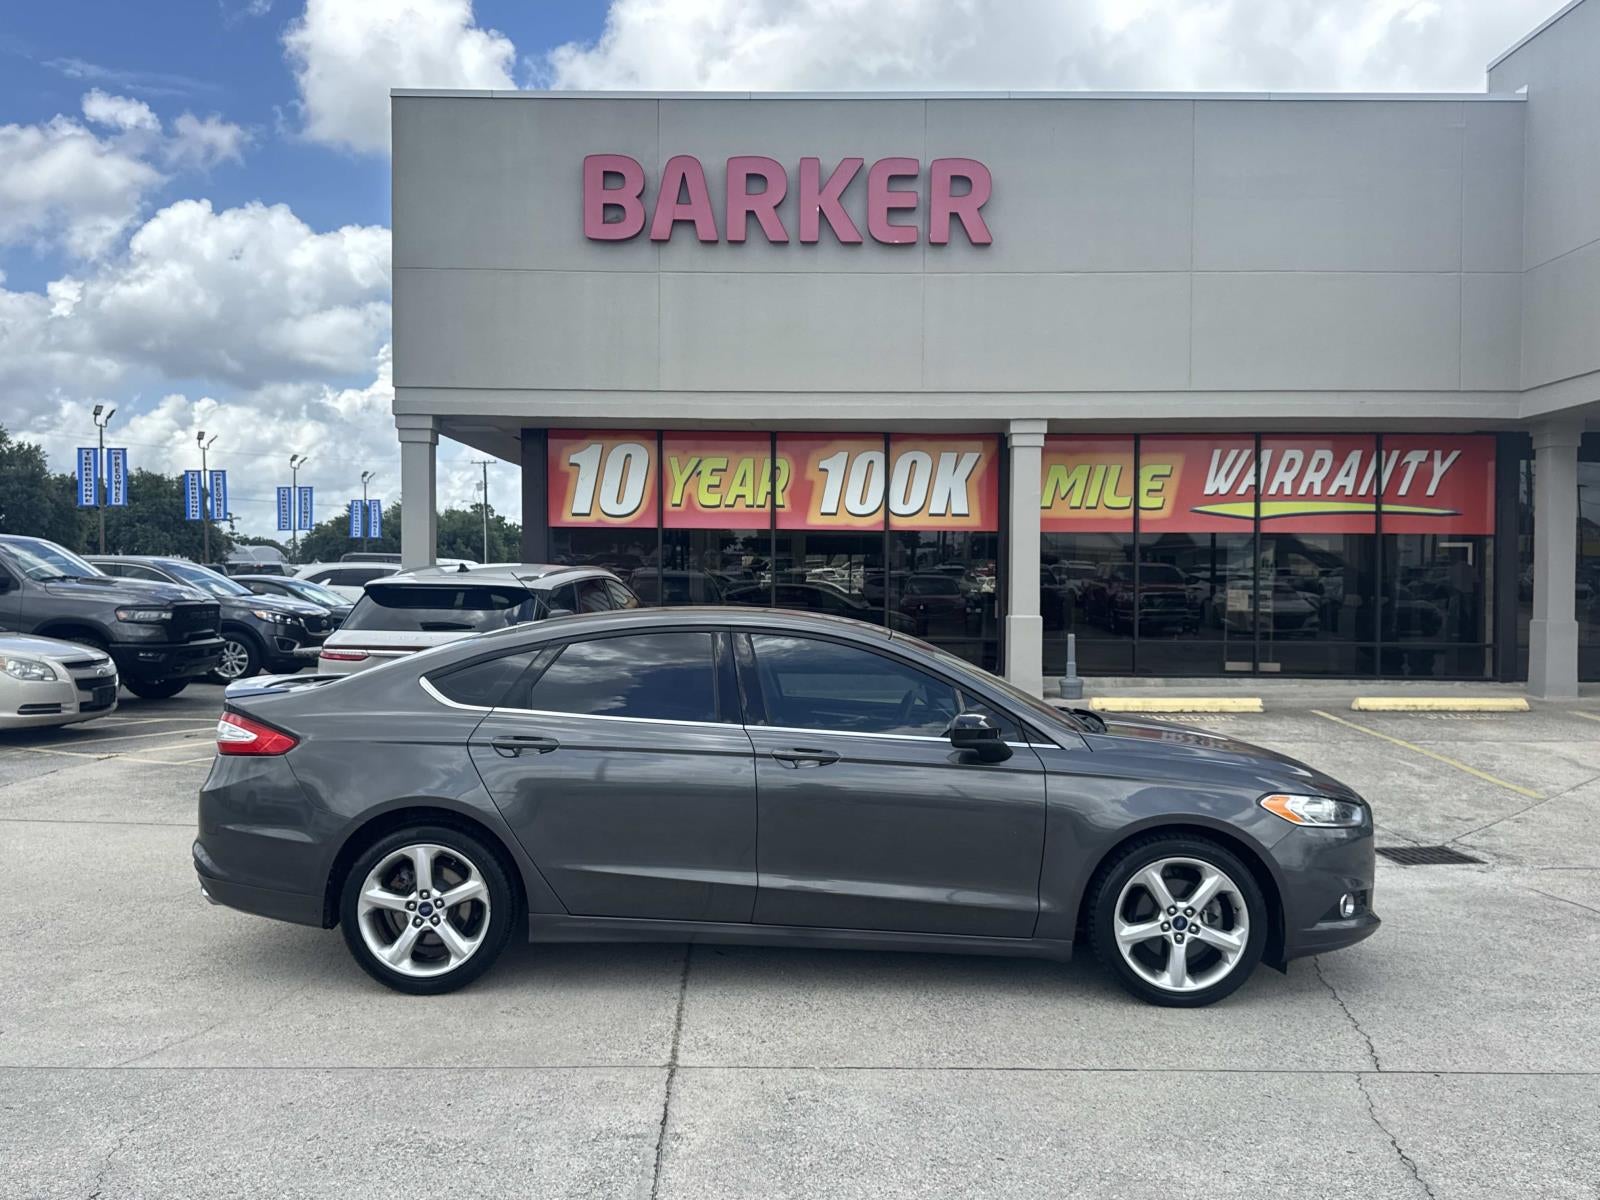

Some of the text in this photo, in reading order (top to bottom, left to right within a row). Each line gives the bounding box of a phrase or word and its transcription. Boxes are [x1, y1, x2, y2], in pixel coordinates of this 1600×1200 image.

[584, 154, 994, 245] BARKER
[84, 450, 93, 503] TERREBONNE
[569, 443, 1462, 518] 10 YEAR 100K MILE WARRANTY
